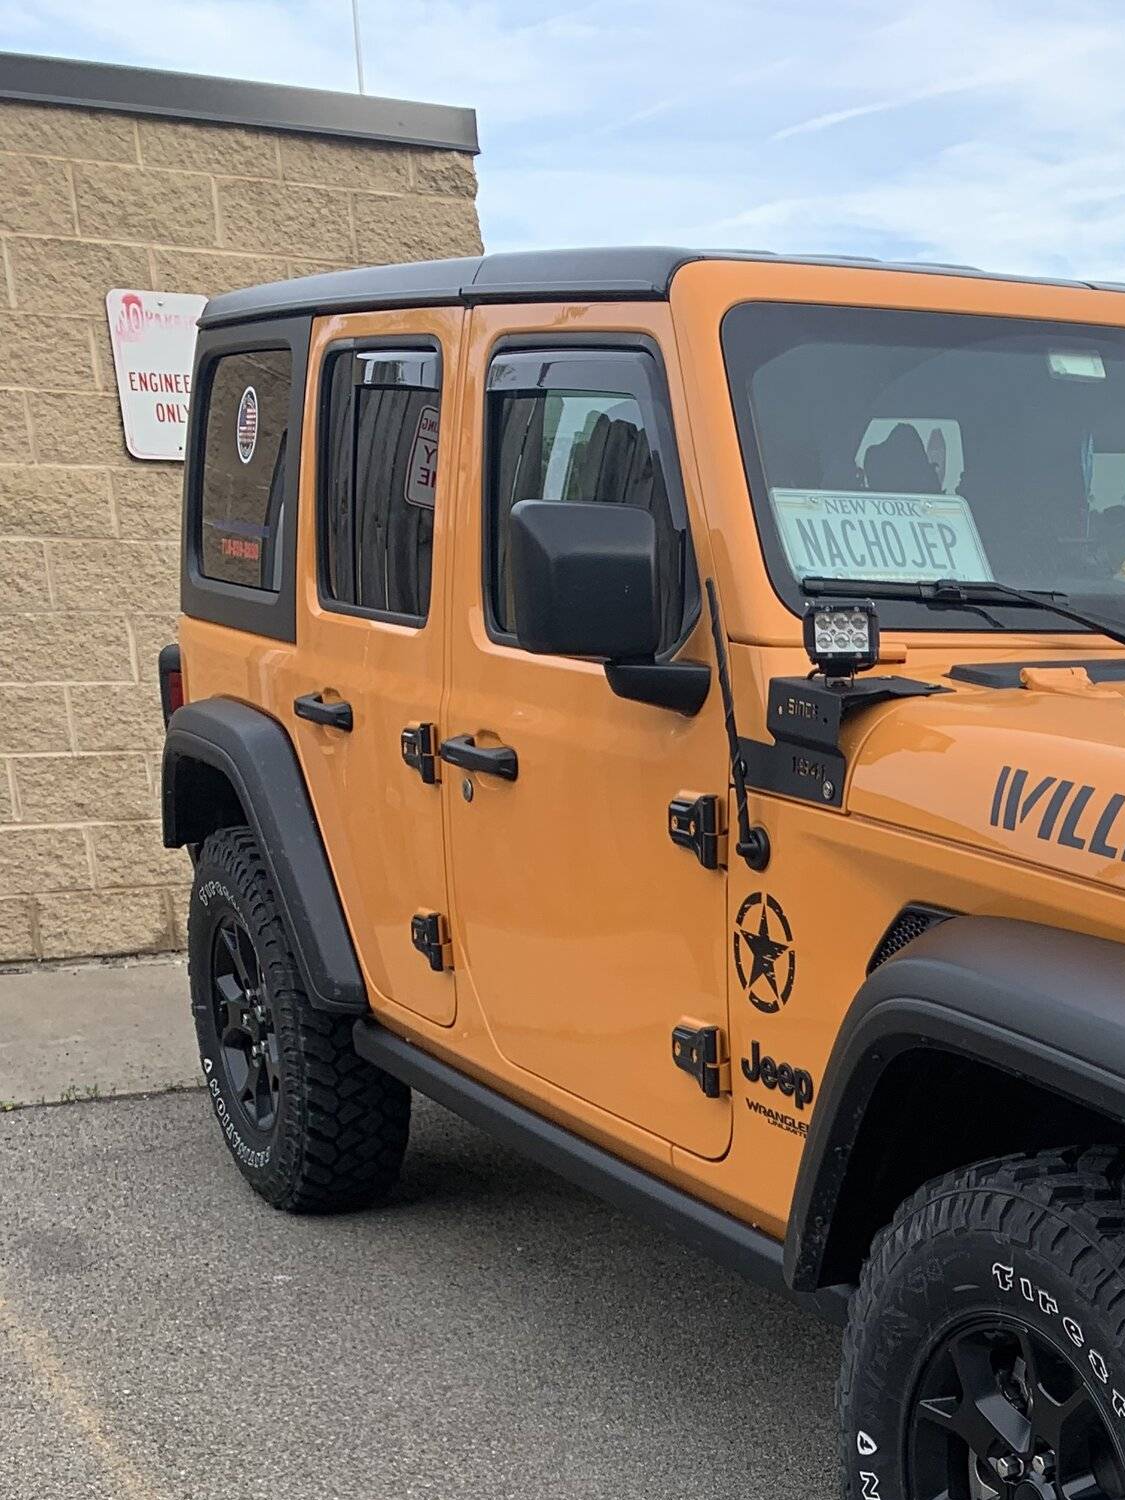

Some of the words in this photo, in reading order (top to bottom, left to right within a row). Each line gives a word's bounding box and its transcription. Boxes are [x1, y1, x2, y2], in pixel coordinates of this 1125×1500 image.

[129, 372, 191, 393] ENGINEE
[824, 499, 867, 515] NEW
[871, 500, 921, 518] YORK
[741, 1040, 814, 1110] Jeep
